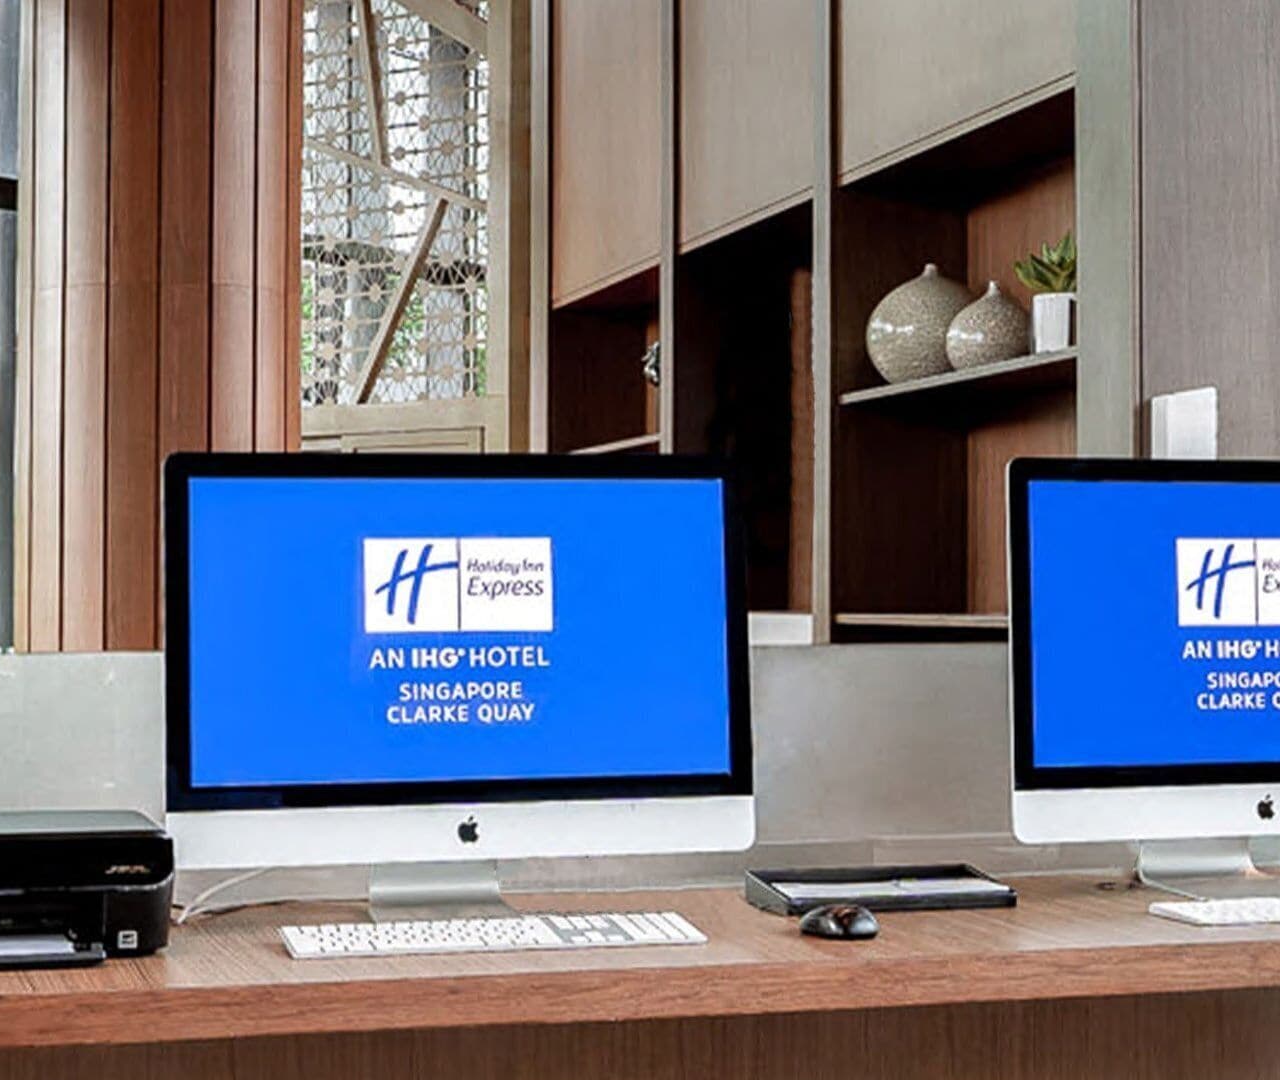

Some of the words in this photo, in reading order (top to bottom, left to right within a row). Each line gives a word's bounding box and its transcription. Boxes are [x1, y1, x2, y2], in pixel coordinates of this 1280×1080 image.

[466, 558, 521, 576] Holiday
[522, 559, 544, 572] Inn
[466, 577, 544, 600] Express
[369, 648, 404, 669] AN
[469, 646, 550, 668] HOTEL
[1182, 640, 1212, 659] AN
[399, 681, 523, 701] SINGAPORE
[1196, 692, 1266, 710] CLARKE
[386, 704, 469, 724] CLARKE
[477, 703, 535, 723] QUAY
